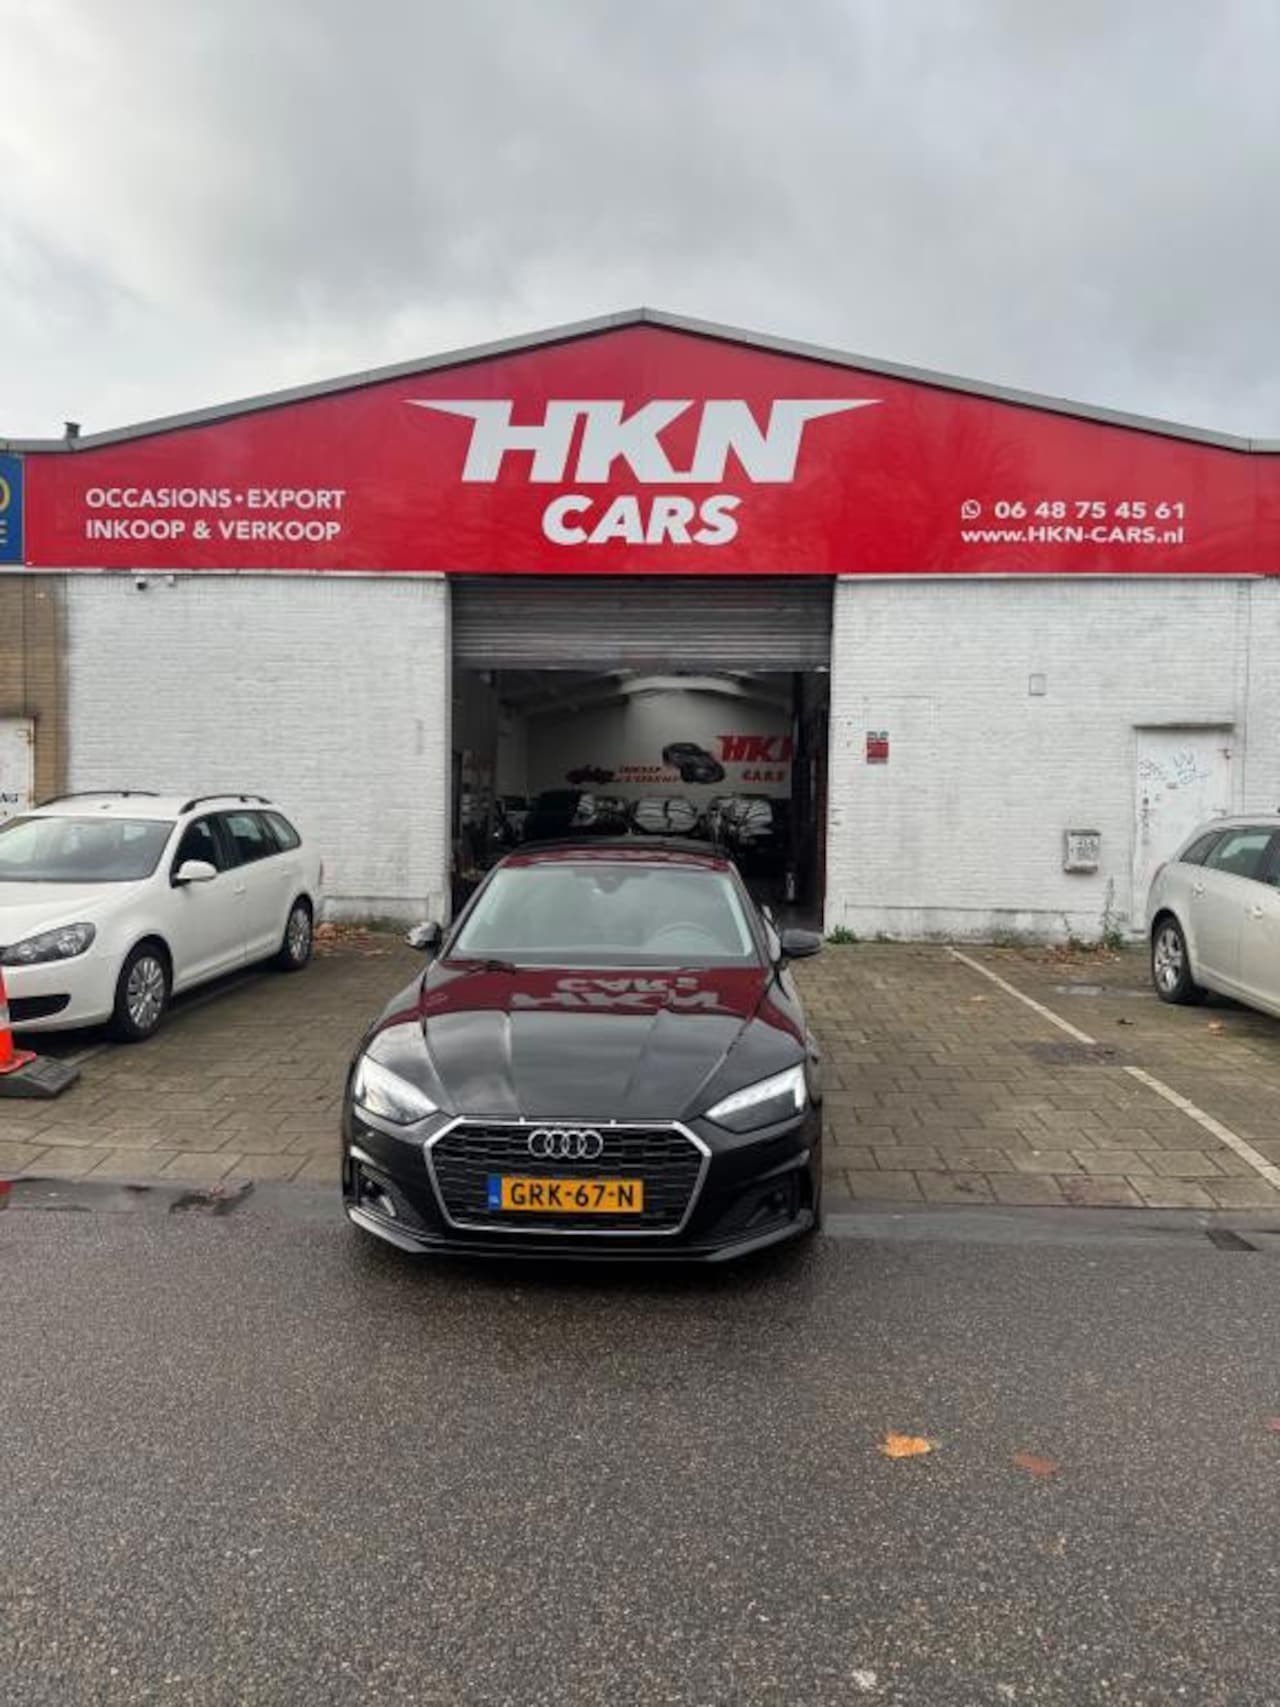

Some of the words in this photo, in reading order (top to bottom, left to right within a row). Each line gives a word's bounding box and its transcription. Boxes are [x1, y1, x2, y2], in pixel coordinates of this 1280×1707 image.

[408, 398, 880, 484] HKN
[542, 494, 741, 546] CARS
[994, 501, 1027, 519] 06
[1034, 501, 1066, 519] 48
[1075, 501, 1106, 519] 75
[1115, 501, 1147, 519] 45
[1154, 501, 1184, 519] 61
[86, 519, 185, 539] INKOOP
[192, 520, 211, 540] &
[218, 520, 341, 541] VERKOOP
[961, 526, 1184, 543] www.HKN-CARS.nl
[510, 1182, 634, 1207] GRK-67-N
